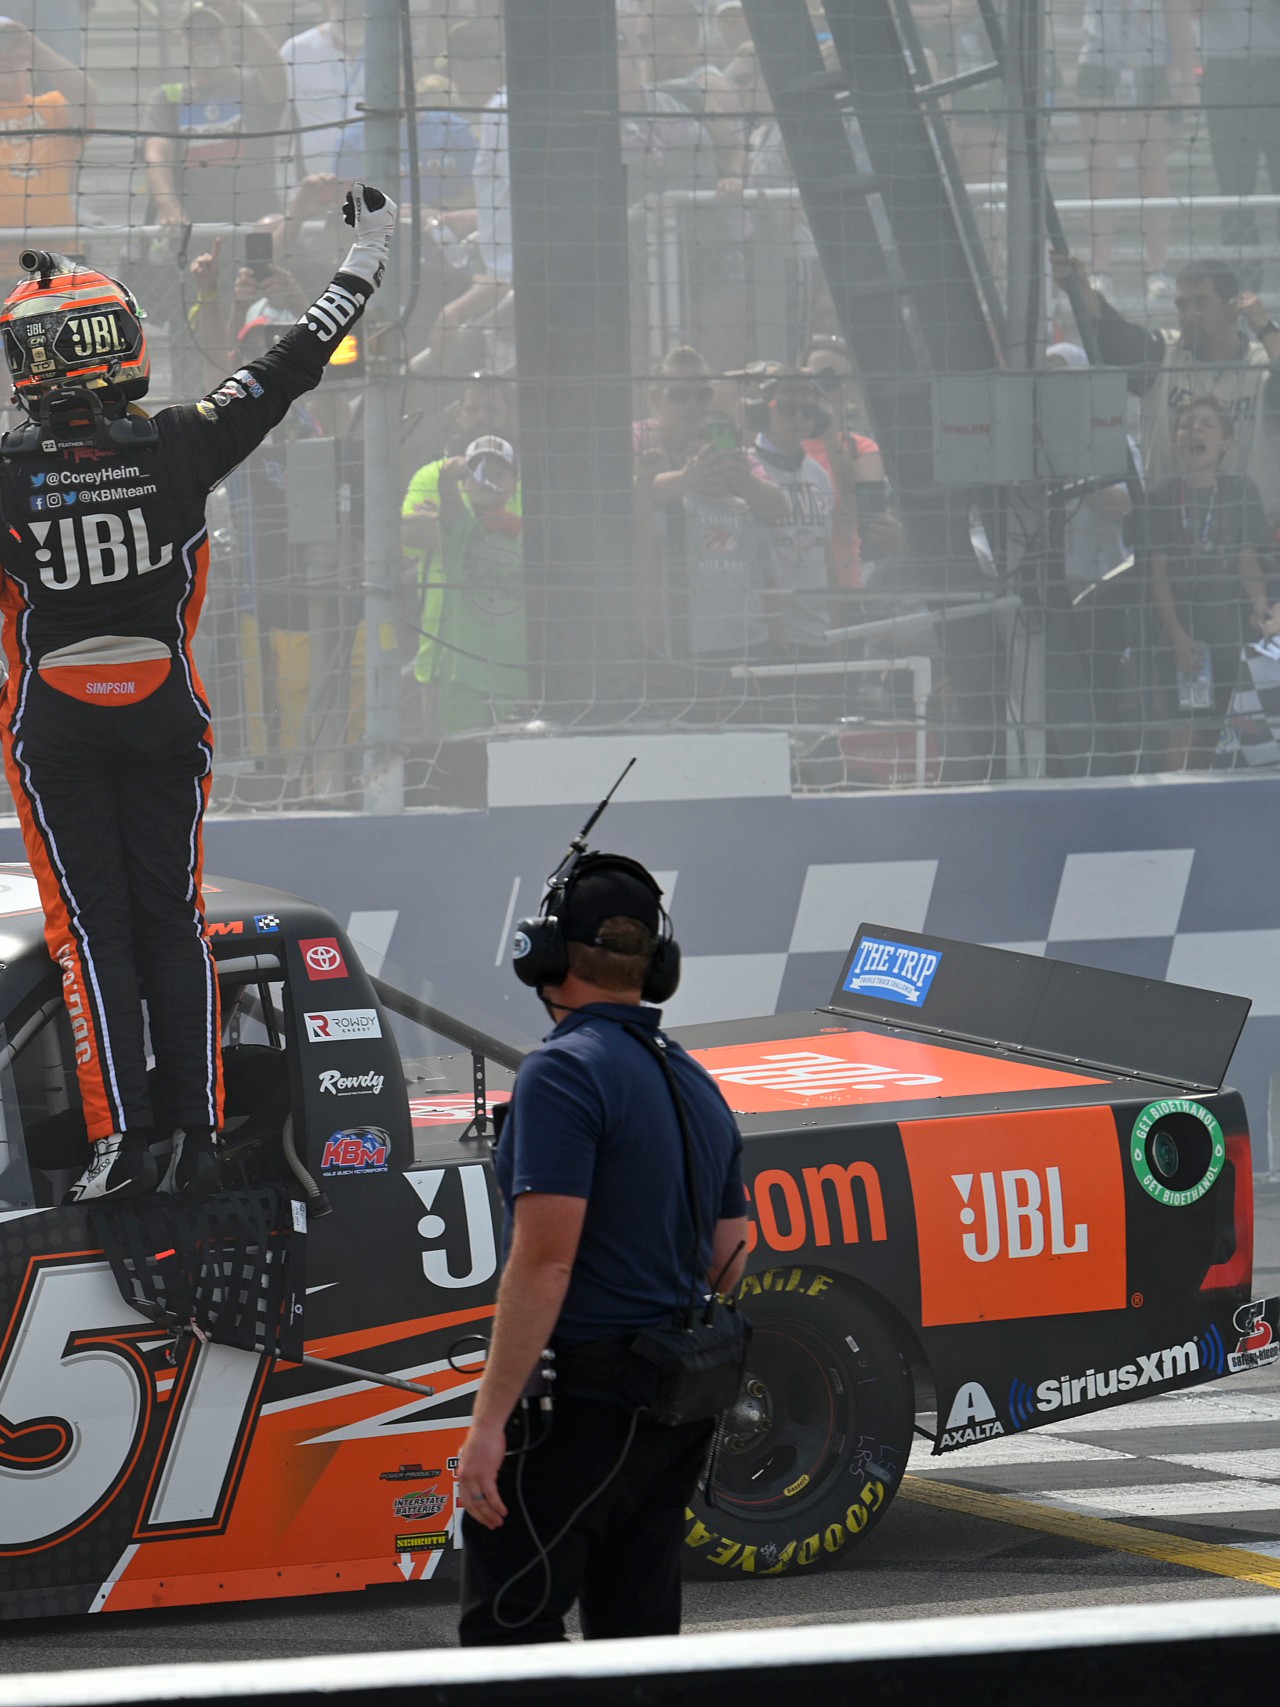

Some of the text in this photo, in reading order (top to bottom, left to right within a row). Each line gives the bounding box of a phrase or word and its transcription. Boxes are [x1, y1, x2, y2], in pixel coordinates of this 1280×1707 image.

[303, 283, 365, 342] JBL
[27, 322, 45, 336] JBL
[70, 314, 126, 356] JBL
[46, 466, 150, 485] @CoreyHeim_
[79, 484, 157, 502] @KBMteam
[33, 508, 173, 590] JBL
[86, 682, 135, 694] SIMPSON
[854, 941, 937, 987] THE TRIP
[331, 1016, 376, 1028] ROWDY
[318, 1070, 385, 1095] Rowdy
[1135, 1101, 1218, 1139] GET BIOETHANOL
[321, 1138, 387, 1168] KBM
[1142, 1165, 1219, 1205] GET BIOETHANOL
[956, 1166, 1089, 1263] JBL
[736, 1267, 834, 1300] AGLE
[939, 1420, 1005, 1449] AXALTA
[394, 1496, 445, 1507] INTERSTATE
[395, 1505, 442, 1515] BATTERIES
